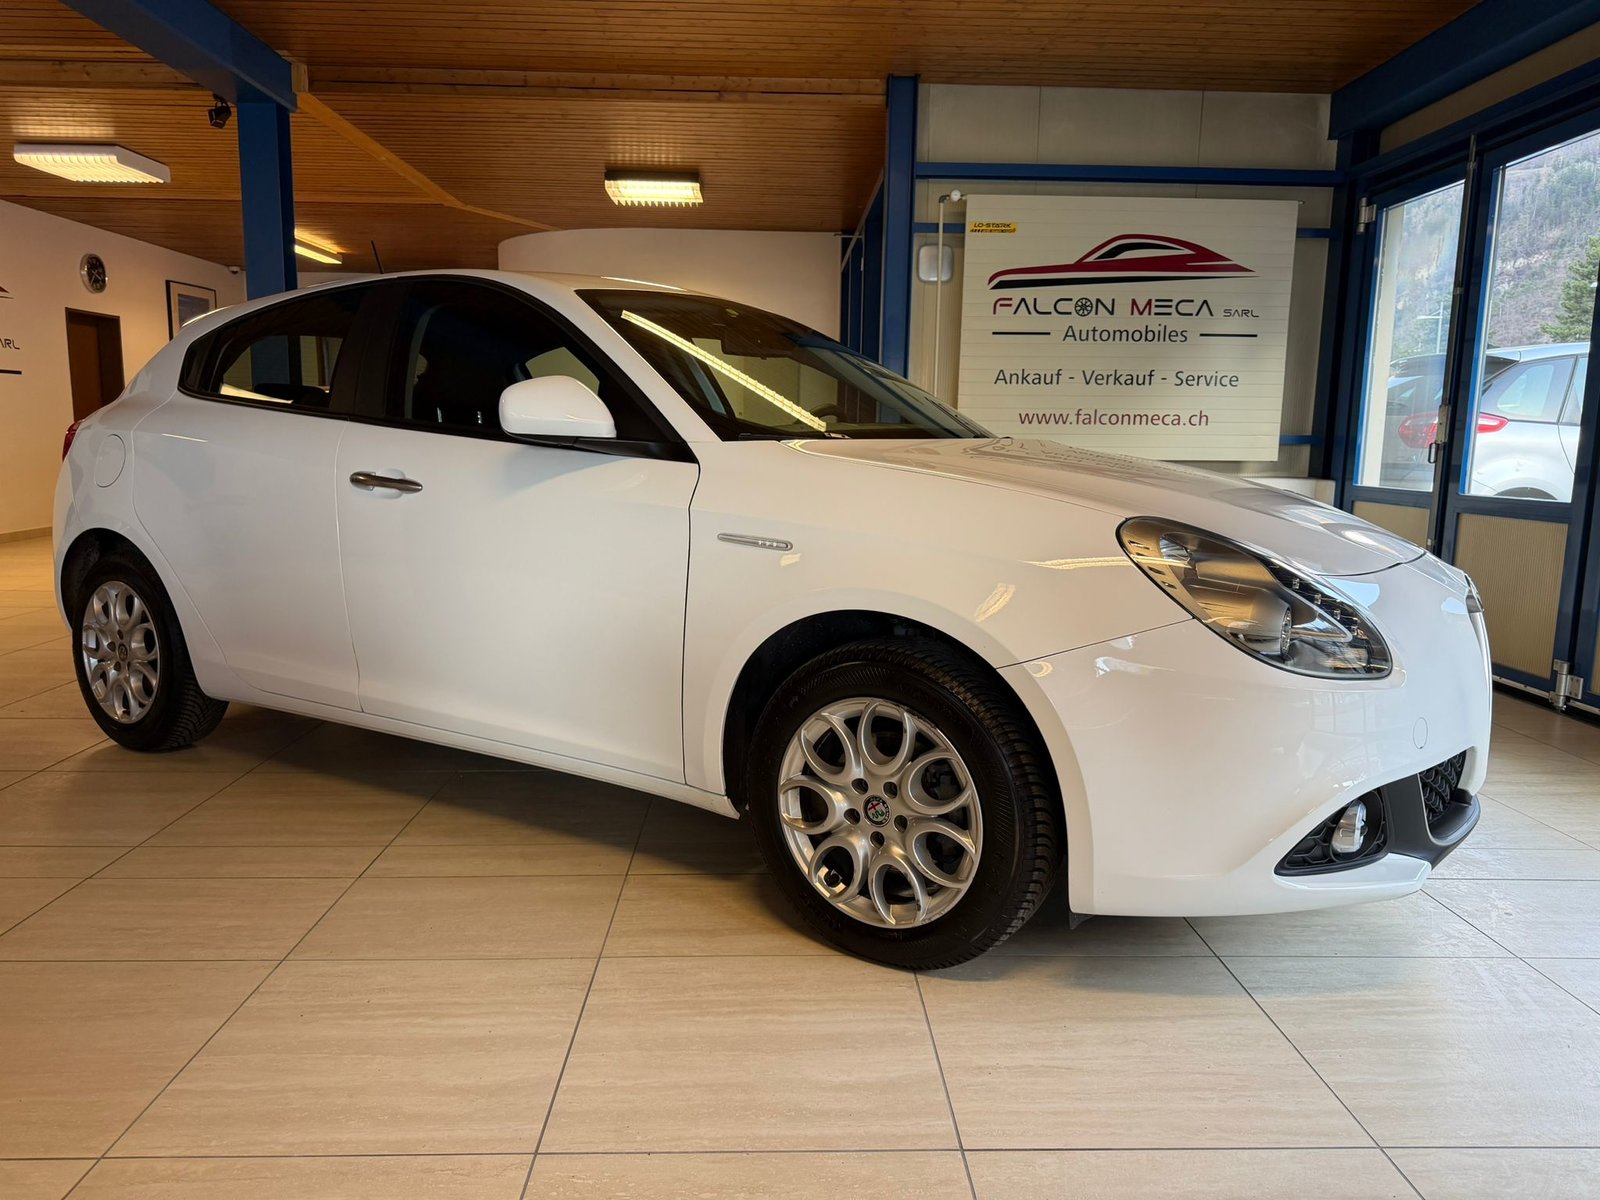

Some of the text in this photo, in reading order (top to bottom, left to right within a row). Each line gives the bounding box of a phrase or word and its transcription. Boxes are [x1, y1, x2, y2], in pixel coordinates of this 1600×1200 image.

[993, 297, 1260, 318] FALCON MECA SARL
[1062, 323, 1188, 343] Automobiles
[994, 368, 1063, 386] Ankauf
[1081, 369, 1156, 387] Verkauf
[1173, 370, 1240, 388] Service
[1018, 408, 1209, 427] www.falconmeca.ch
